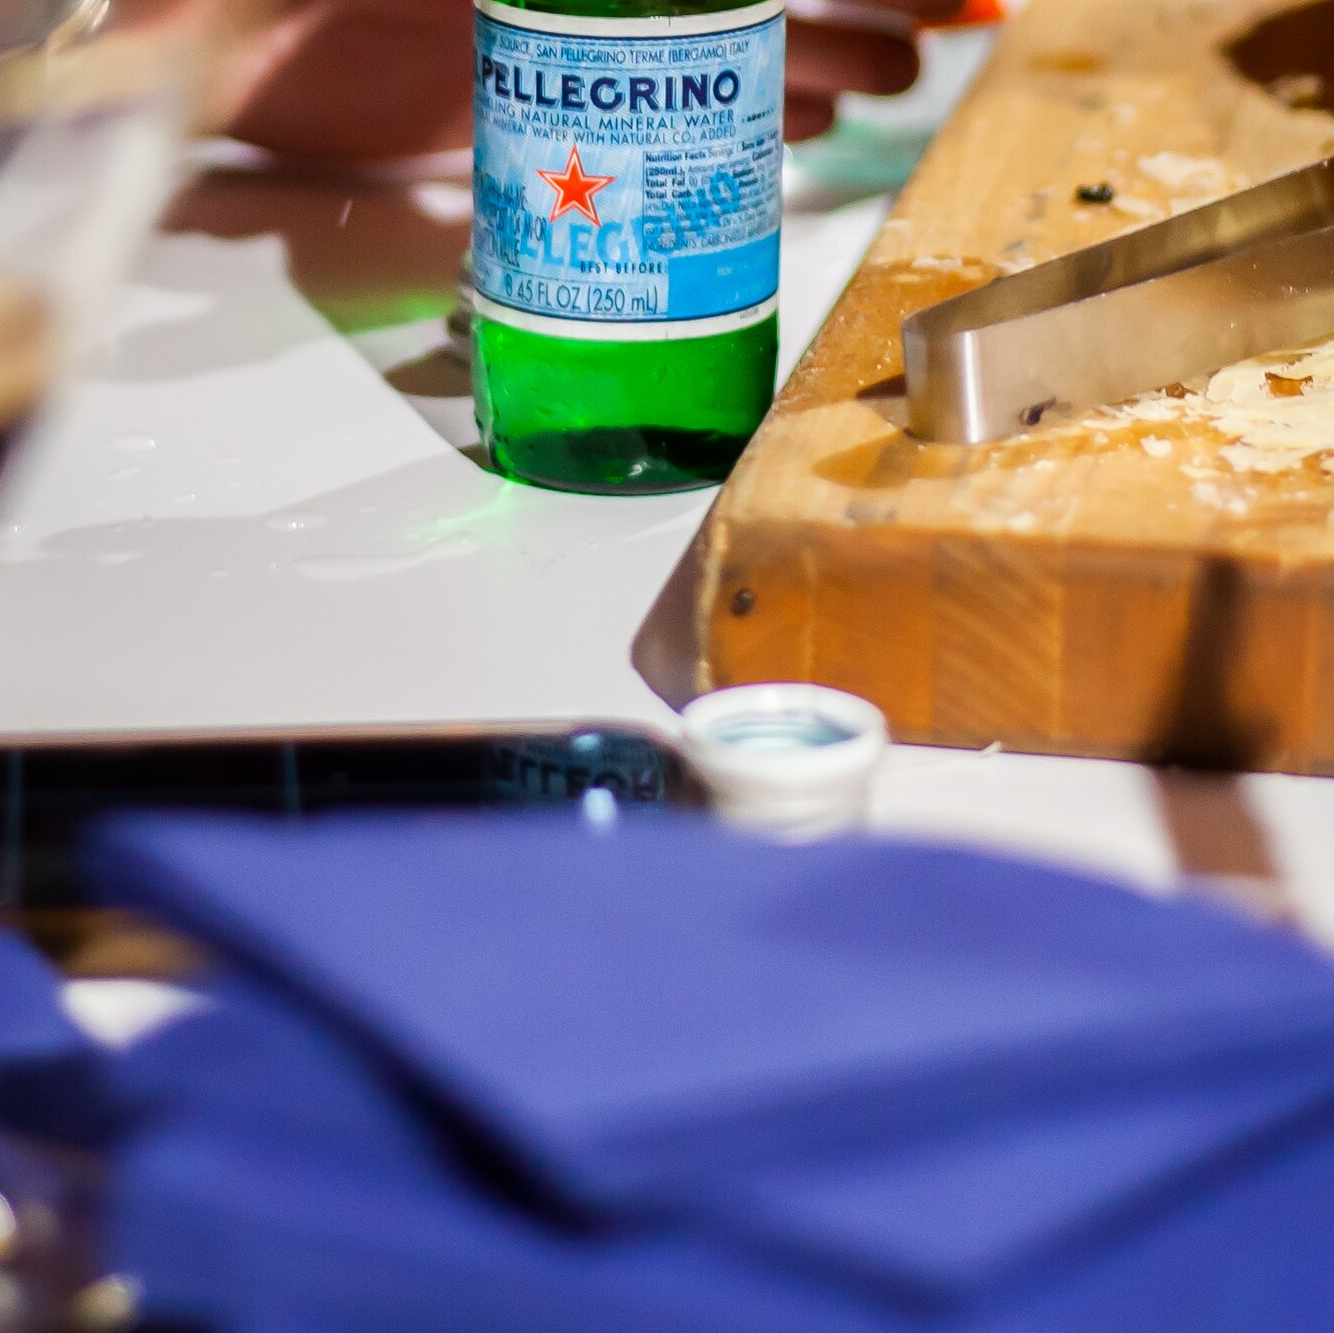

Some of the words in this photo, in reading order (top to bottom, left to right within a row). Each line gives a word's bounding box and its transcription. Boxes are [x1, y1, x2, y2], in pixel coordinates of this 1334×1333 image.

[537, 43, 558, 59] SAN
[560, 46, 626, 64] PELLEGRINO
[630, 49, 664, 64] TERME
[729, 39, 750, 56] ITALY
[521, 107, 592, 130] NATURAL
[598, 114, 675, 131] MINERAL
[683, 109, 734, 128] WATER
[532, 126, 568, 142] WATER
[573, 131, 605, 144] WITH
[610, 129, 666, 145] NATURAL
[700, 125, 736, 141] ADDED
[580, 261, 609, 275] BEST
[537, 282, 553, 307] FL
[556, 284, 582, 310] OZ
[587, 285, 625, 314] (250
[632, 284, 658, 315] mL)
